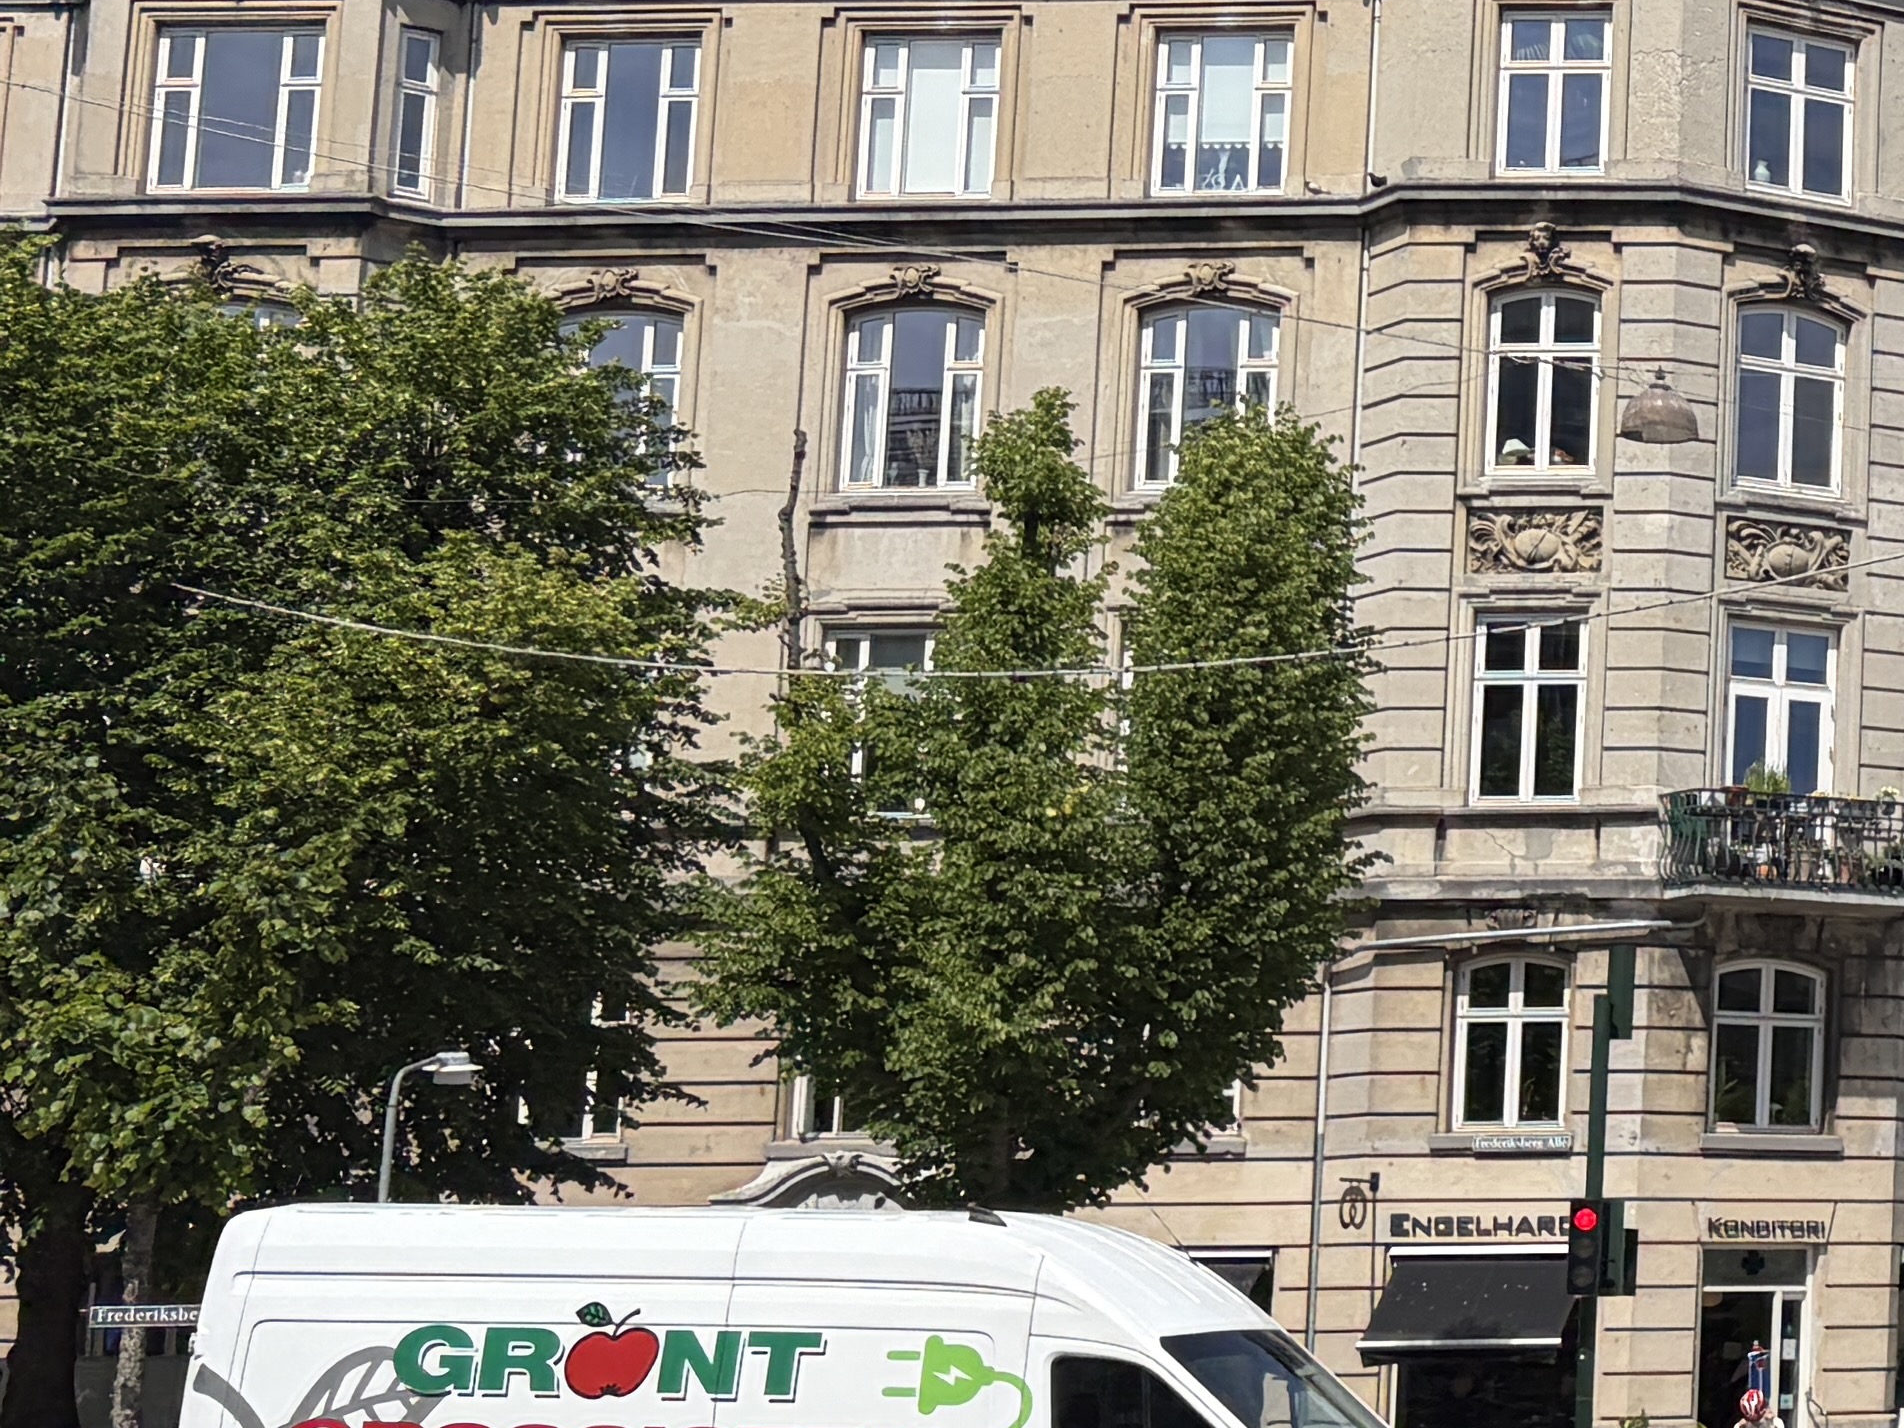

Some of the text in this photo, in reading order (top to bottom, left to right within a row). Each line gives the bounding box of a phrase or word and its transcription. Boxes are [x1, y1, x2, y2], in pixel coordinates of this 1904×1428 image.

[1390, 1213, 1570, 1237] ENGELHARD
[1708, 1217, 1826, 1239] KONDITORI
[96, 1307, 198, 1322] Frederiksbe
